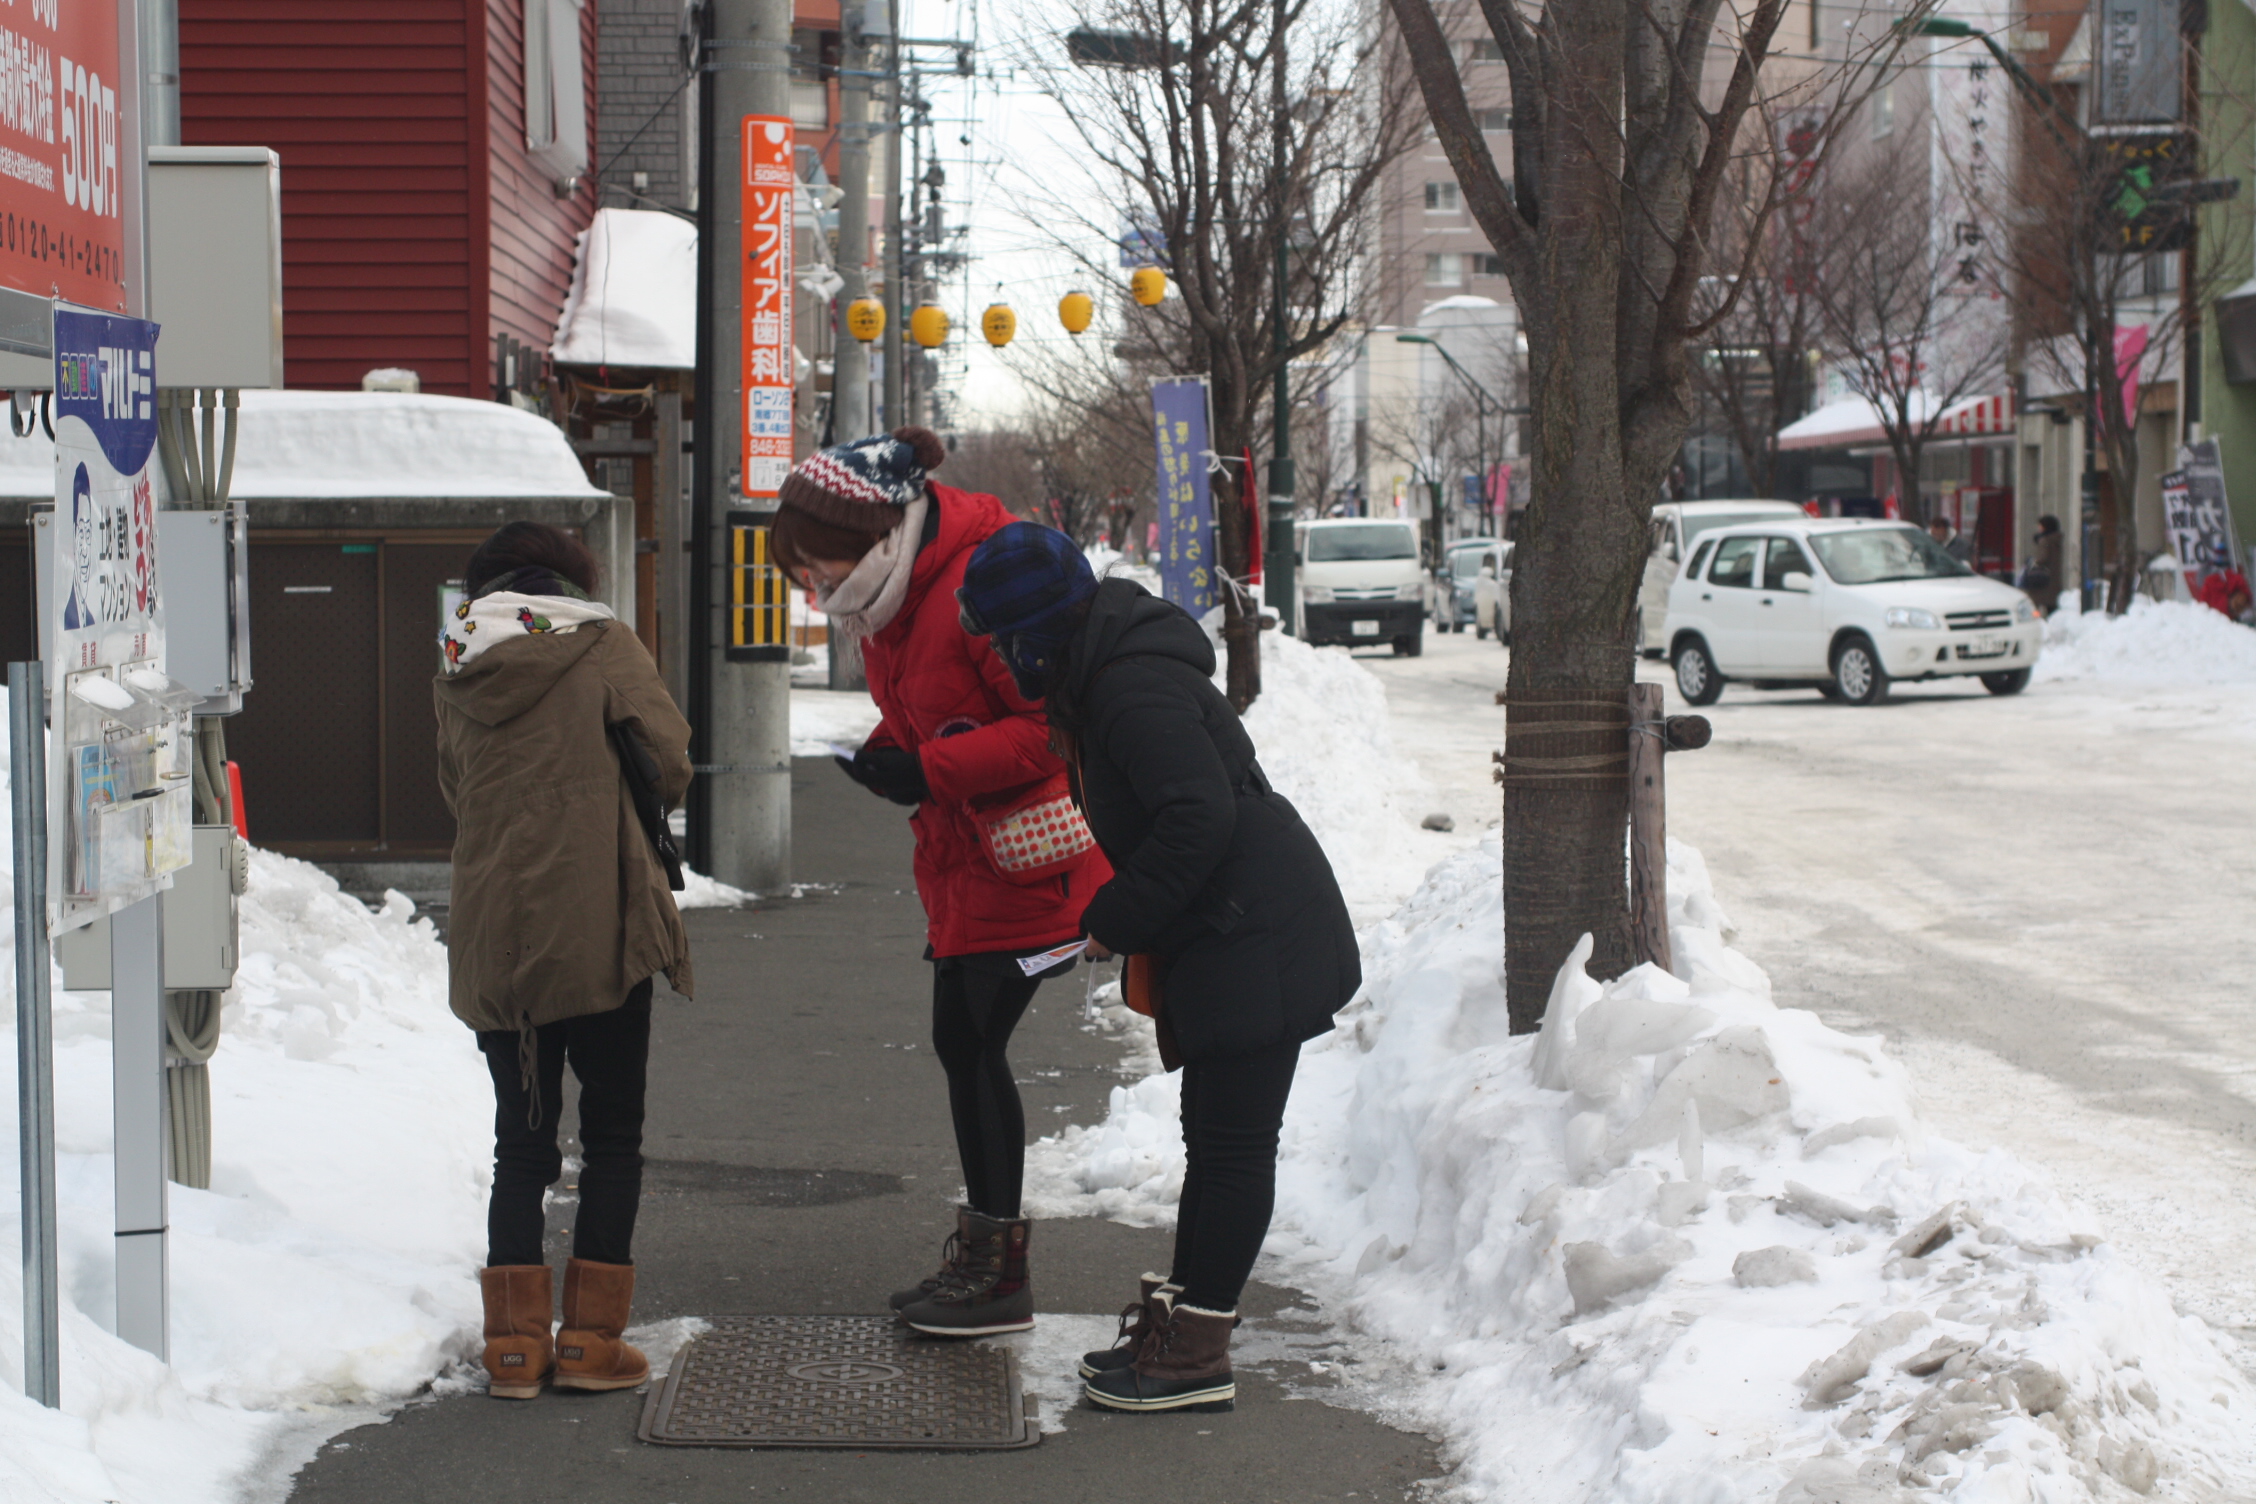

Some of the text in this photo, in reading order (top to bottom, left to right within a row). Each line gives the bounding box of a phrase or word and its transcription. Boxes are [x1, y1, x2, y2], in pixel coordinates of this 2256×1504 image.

[60, 56, 117, 218] 500円
[8, 212, 119, 284] 0120-41-2470
[751, 191, 780, 383] ソフィア歯科
[99, 346, 151, 420] マルトミ
[99, 572, 131, 622] マンション
